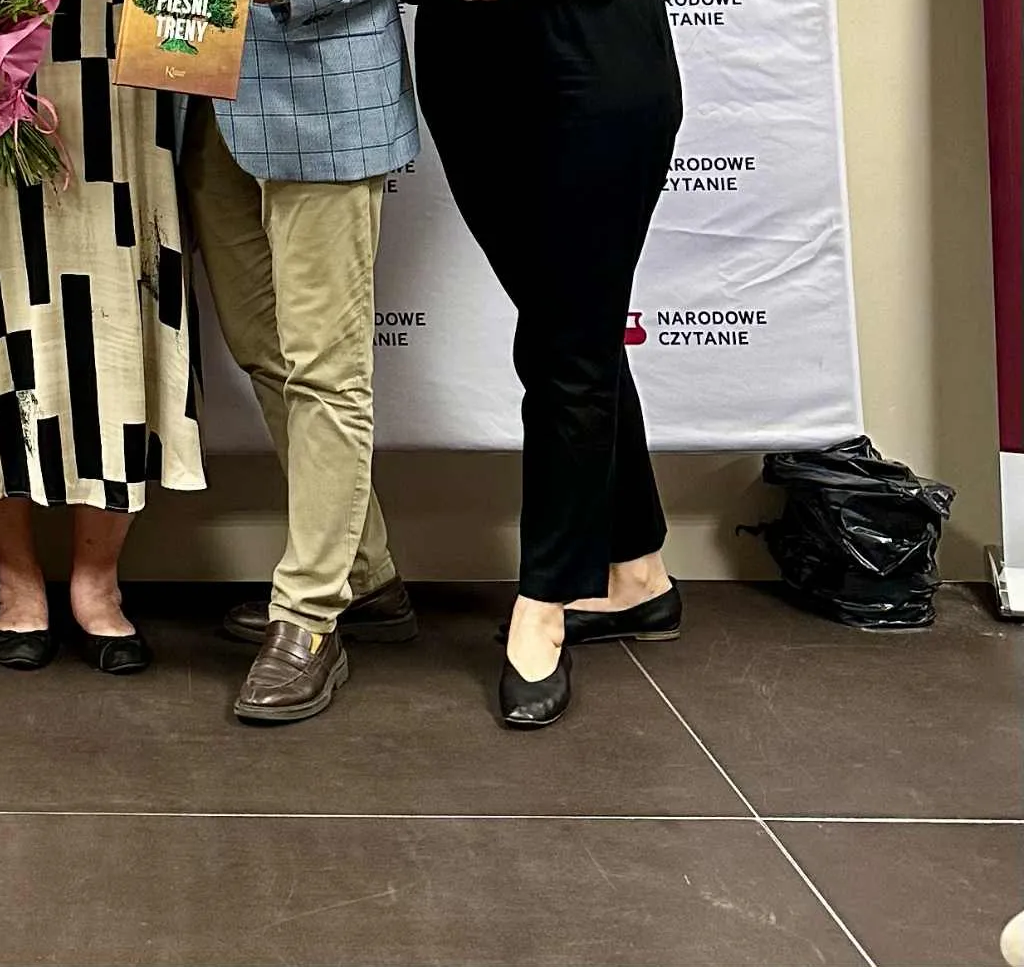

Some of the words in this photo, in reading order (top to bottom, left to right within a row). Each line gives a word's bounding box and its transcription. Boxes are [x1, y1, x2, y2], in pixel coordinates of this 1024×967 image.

[670, 12, 725, 26] TANIE
[156, 15, 208, 43] TRENY
[658, 311, 767, 325] NARODOWE
[659, 331, 748, 345] CZYTANIE
